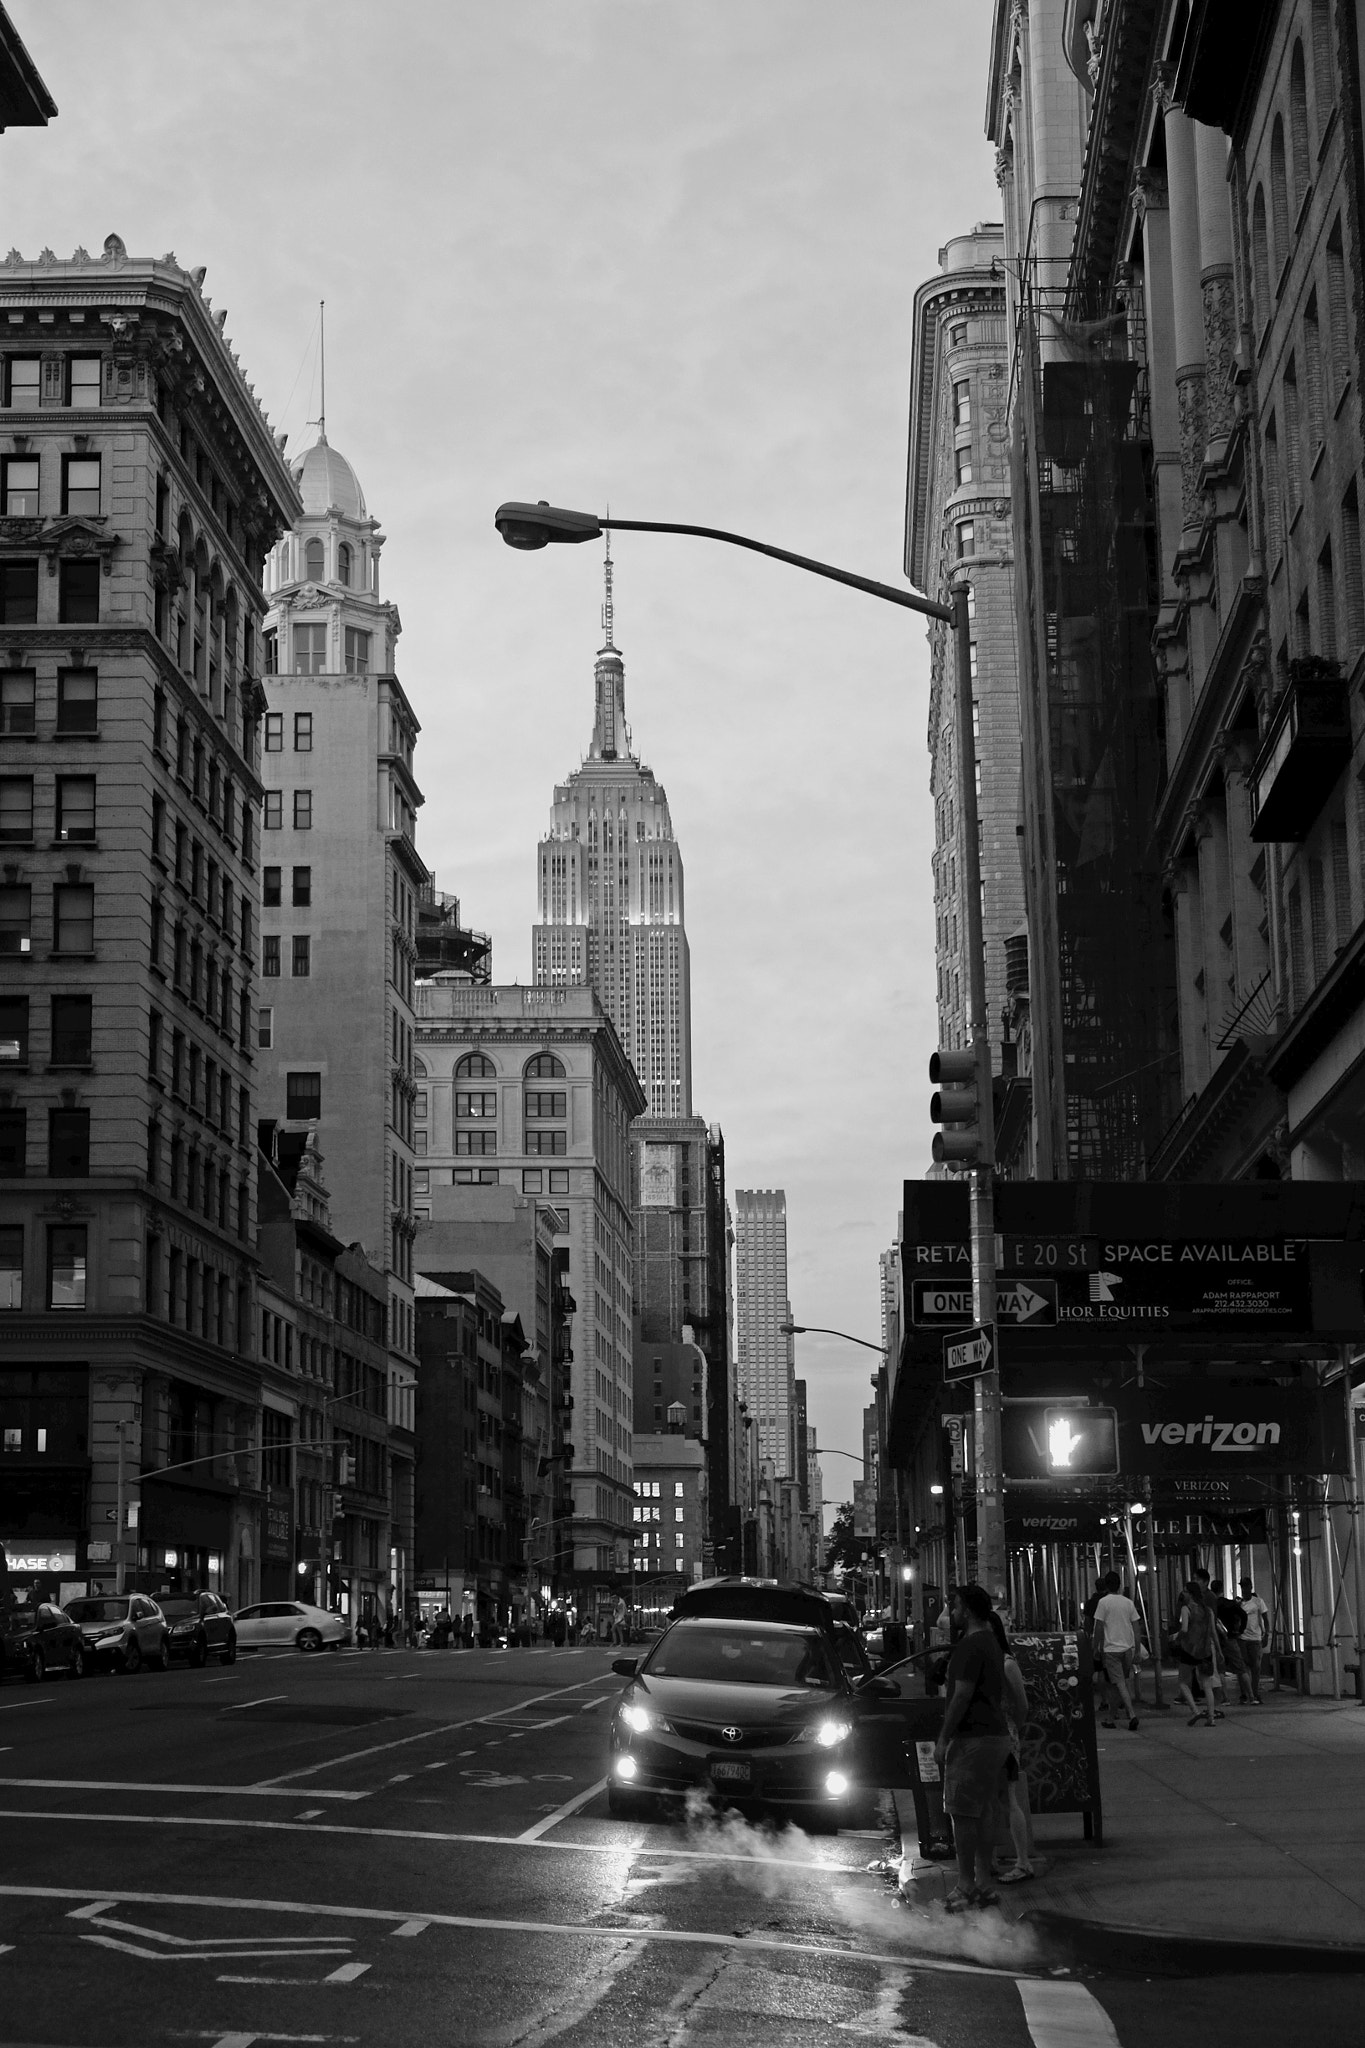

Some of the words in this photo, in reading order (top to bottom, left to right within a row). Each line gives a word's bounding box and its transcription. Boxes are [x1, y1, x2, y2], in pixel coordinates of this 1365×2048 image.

[916, 1246, 971, 1263] RETA
[1104, 1245, 1173, 1262] SPACE
[1180, 1245, 1296, 1262] AVAILABLE
[1015, 1244, 1024, 1265] E
[1034, 1244, 1057, 1265] 20
[1068, 1244, 1088, 1265] St
[934, 1294, 972, 1311] ONE
[1060, 1306, 1094, 1317] HOR
[952, 1345, 967, 1365] ONE
[973, 1340, 988, 1360] WAY
[1141, 1415, 1281, 1451] verizon
[1174, 1480, 1229, 1491] VERIZON
[1022, 1515, 1077, 1530] verizon
[7, 1558, 47, 1570] HASE
[928, 1597, 936, 1608] P
